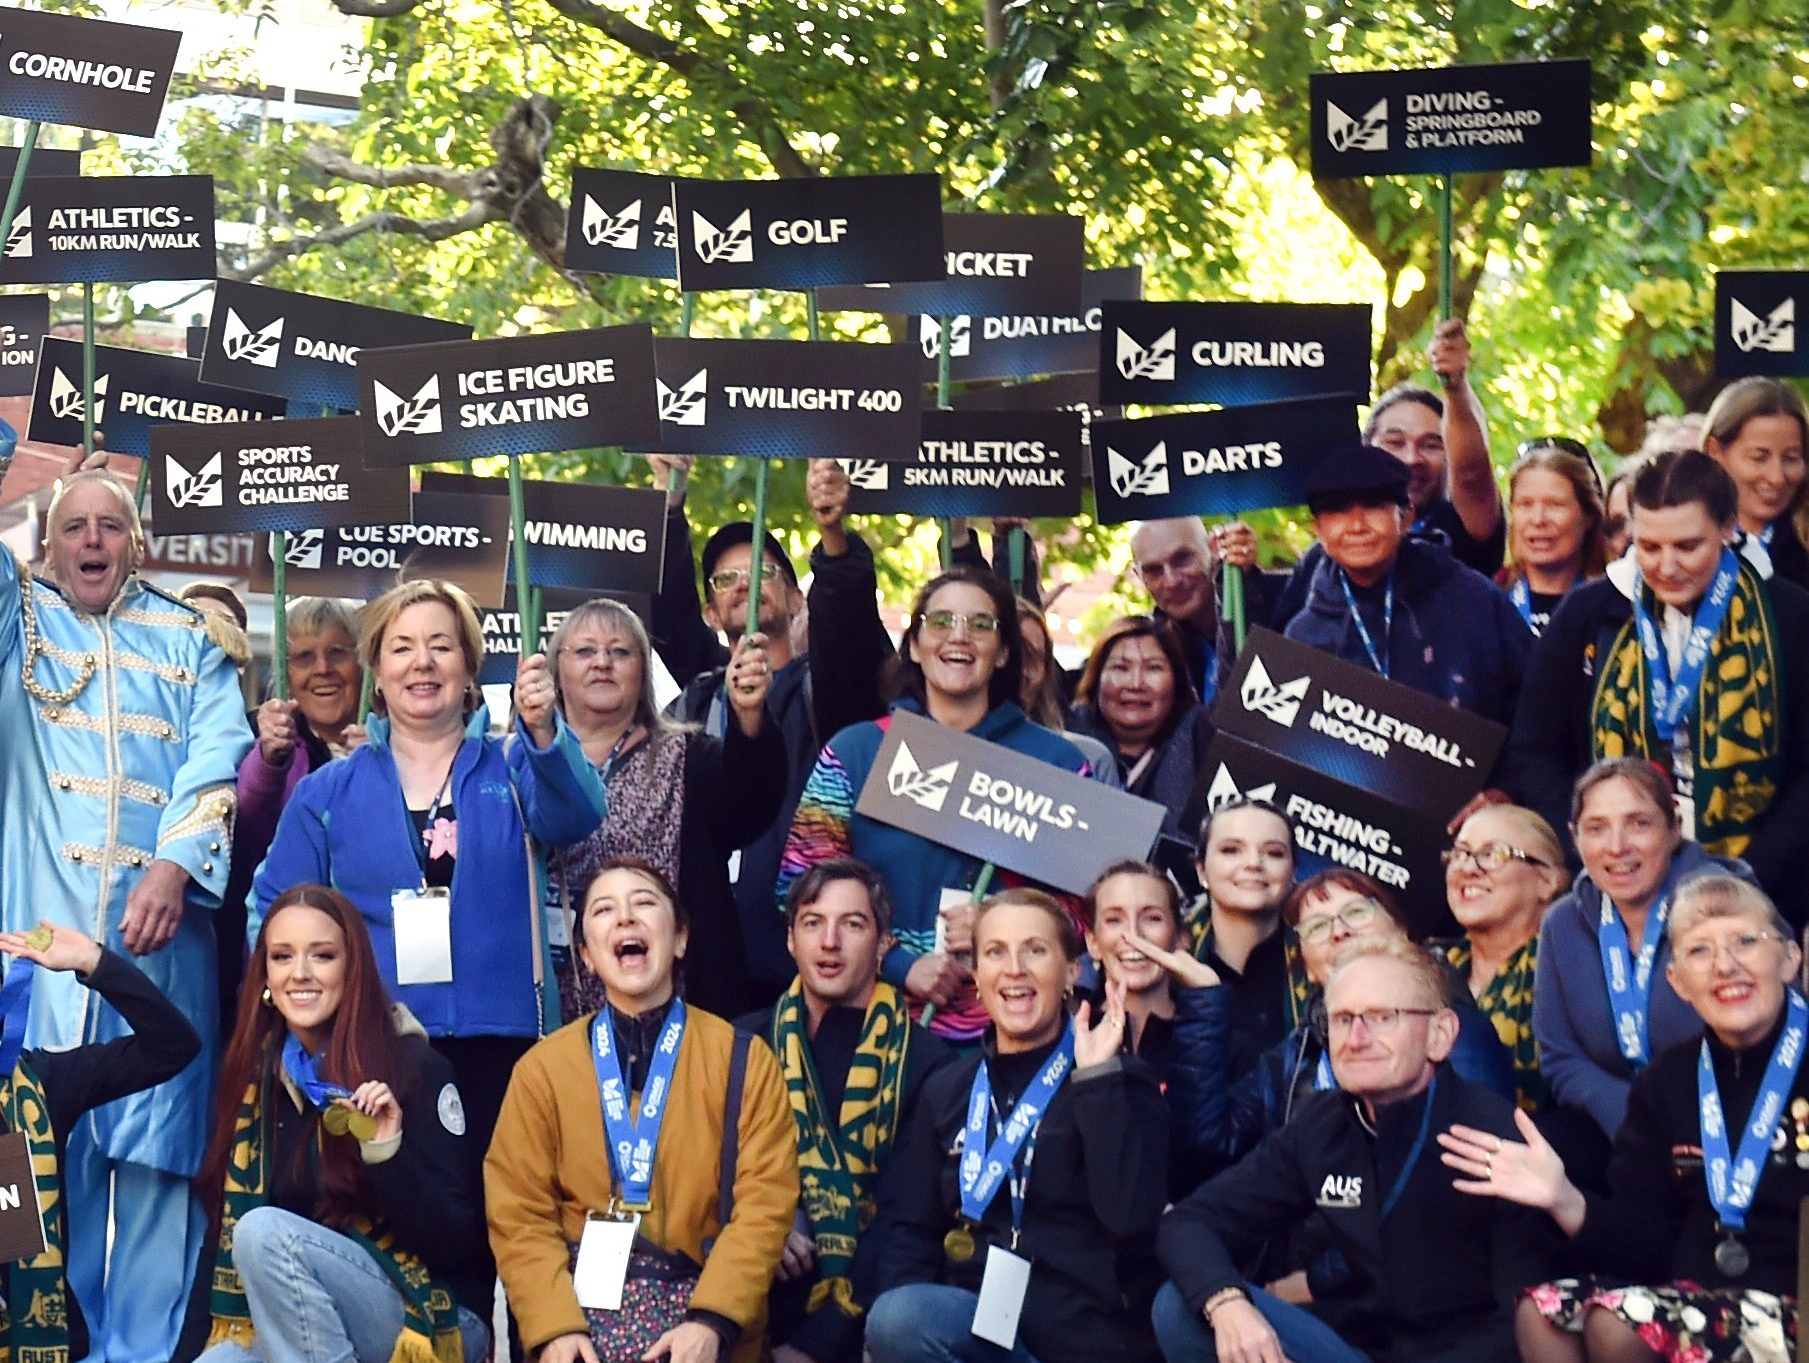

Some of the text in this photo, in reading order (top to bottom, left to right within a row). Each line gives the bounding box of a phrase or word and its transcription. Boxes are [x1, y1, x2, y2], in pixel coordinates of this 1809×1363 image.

[10, 52, 155, 93] CORNHOLE
[1407, 110, 1541, 131] SPRINGBOARD
[1406, 129, 1522, 148] & PLATFORM
[49, 233, 201, 251] 10KM RUN/WALK
[768, 219, 847, 245] GOLF
[945, 252, 1033, 276] ICKET
[1192, 341, 1324, 367] CURLING
[459, 359, 614, 395] ICE FIGURE
[460, 394, 588, 427] SKATING
[725, 387, 901, 411] TWILIGHT 400
[238, 446, 311, 465] SPORTS
[1183, 442, 1282, 475] DARTS
[239, 464, 339, 485] ACCURACY
[904, 468, 1065, 488] 5KM RUN/WALK
[239, 484, 349, 505] CHALLENGE
[339, 526, 384, 542] CUE
[509, 520, 647, 553] WIMMING
[337, 547, 402, 568] POOL
[1310, 711, 1389, 757] INDOOR
[960, 797, 1038, 842] LAWN
[660, 1012, 682, 1054] 2024
[1321, 1174, 1363, 1198] AUS
